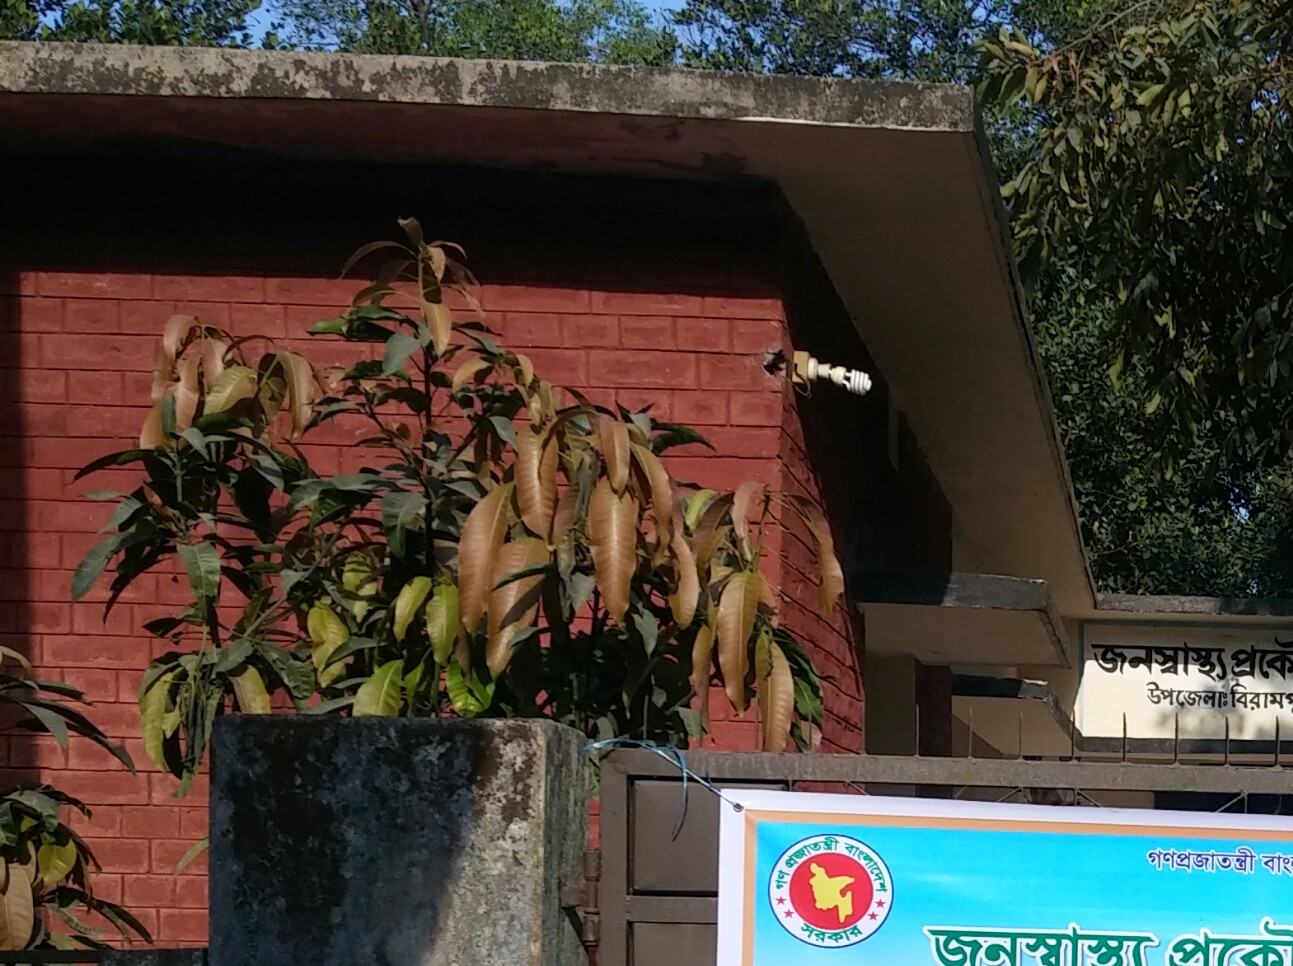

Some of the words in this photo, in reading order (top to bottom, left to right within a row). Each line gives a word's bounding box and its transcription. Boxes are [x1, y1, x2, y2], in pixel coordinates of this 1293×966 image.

[1090, 642, 1227, 682] জনস্বাস্থ্য
[1147, 848, 1256, 873] গণপ্রজাতন্ত্রী
[801, 922, 863, 944] সরকার
